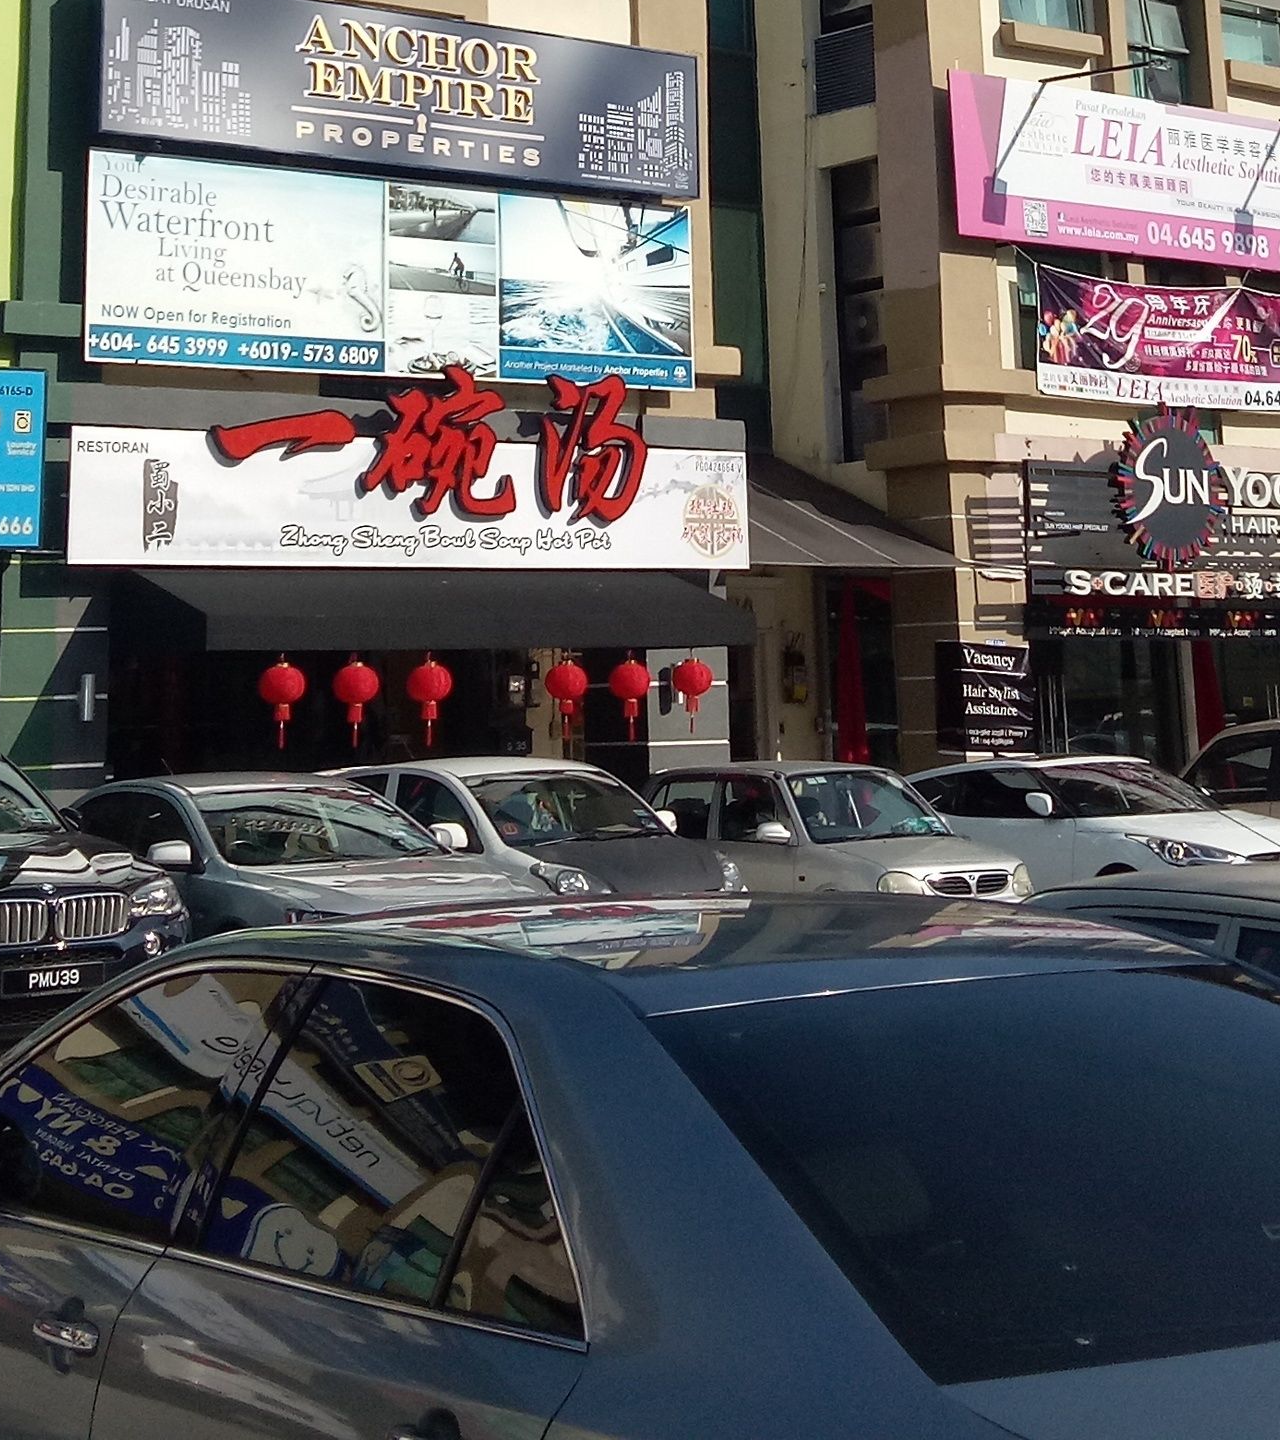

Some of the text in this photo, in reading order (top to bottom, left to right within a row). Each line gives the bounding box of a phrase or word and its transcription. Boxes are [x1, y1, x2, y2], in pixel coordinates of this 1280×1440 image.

[295, 14, 541, 85] ANCHOR
[303, 58, 535, 126] EMPIRE
[1075, 99, 1099, 113] Pusat
[295, 120, 541, 167] PROPERTIES
[1070, 113, 1166, 167] LEIA
[1170, 151, 1235, 178] Aesthetic
[100, 173, 217, 207] Desirable
[99, 199, 275, 243] Waterfront
[1057, 223, 1140, 243] www.leia.com.my
[157, 237, 227, 268] Living
[1147, 221, 1270, 259] 04.645 9898
[155, 261, 307, 299] at Queensbay
[101, 304, 292, 329] NOW Open for Registration
[89, 332, 379, 366] +604- 645 3999 +6019- 573 6809
[534, 361, 558, 372] Project
[1116, 376, 1164, 401] LEIA
[77, 440, 149, 454] RESTORAN
[1124, 437, 1210, 524] SUN
[280, 523, 613, 556] Zhong Sheng Bowl Soup Hot Pot
[1231, 515, 1279, 537] HAIR
[963, 648, 1016, 670] Vacancy
[963, 684, 1021, 702] Hair Stylist
[965, 701, 1018, 716] Assistance
[28, 968, 80, 990] PMU39
